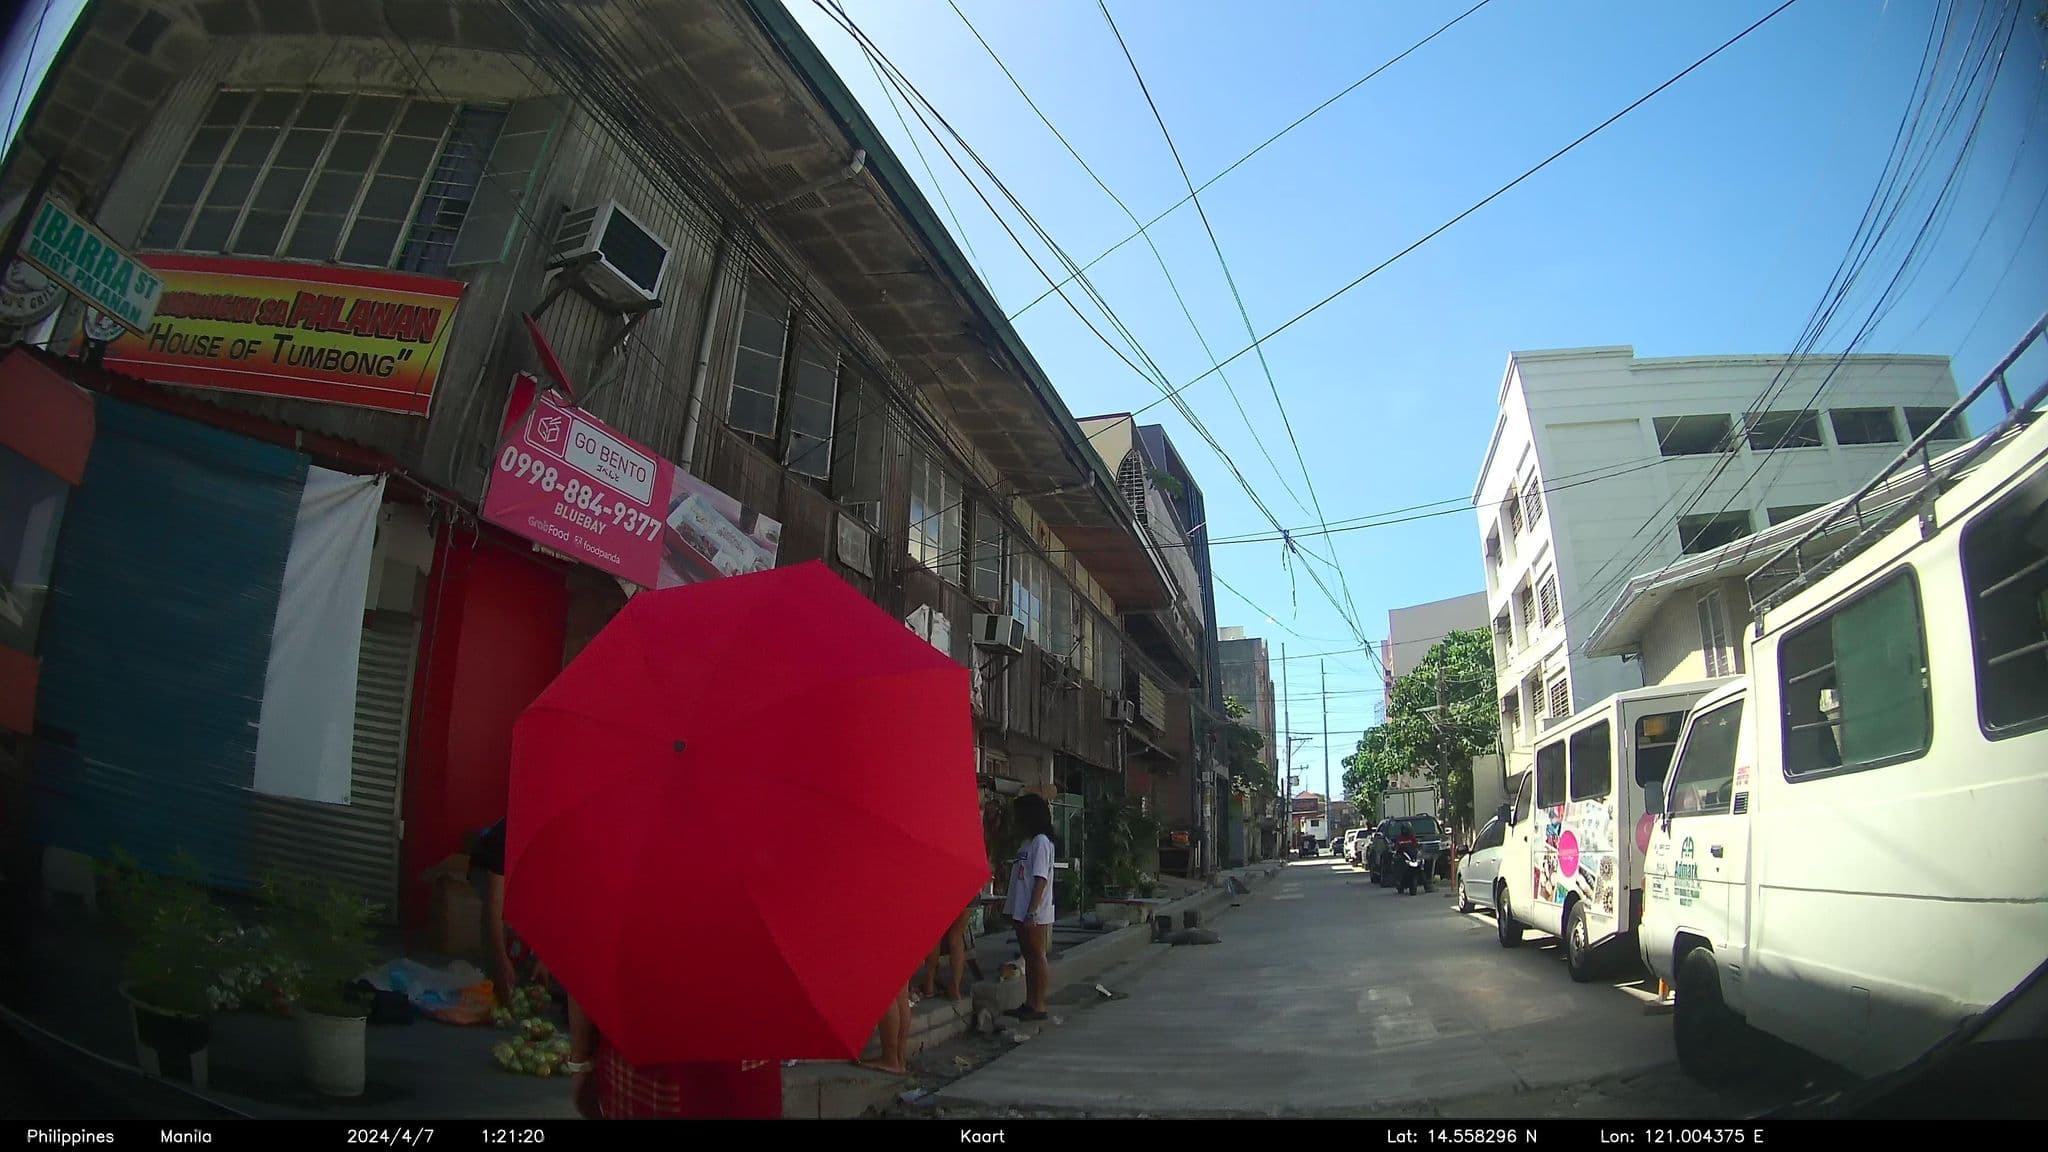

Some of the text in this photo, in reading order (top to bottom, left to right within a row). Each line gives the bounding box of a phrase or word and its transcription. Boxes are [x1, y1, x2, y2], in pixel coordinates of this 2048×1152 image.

[32, 201, 159, 299] IBARRA ST
[73, 269, 142, 323] PALANAN
[286, 290, 441, 344] PALANAN
[574, 432, 647, 483] GO BENTO
[500, 446, 663, 542] 0998-884-9377
[554, 502, 607, 536] BLUEBAY
[528, 516, 570, 541] GrabFood
[583, 540, 622, 565] foodpanda
